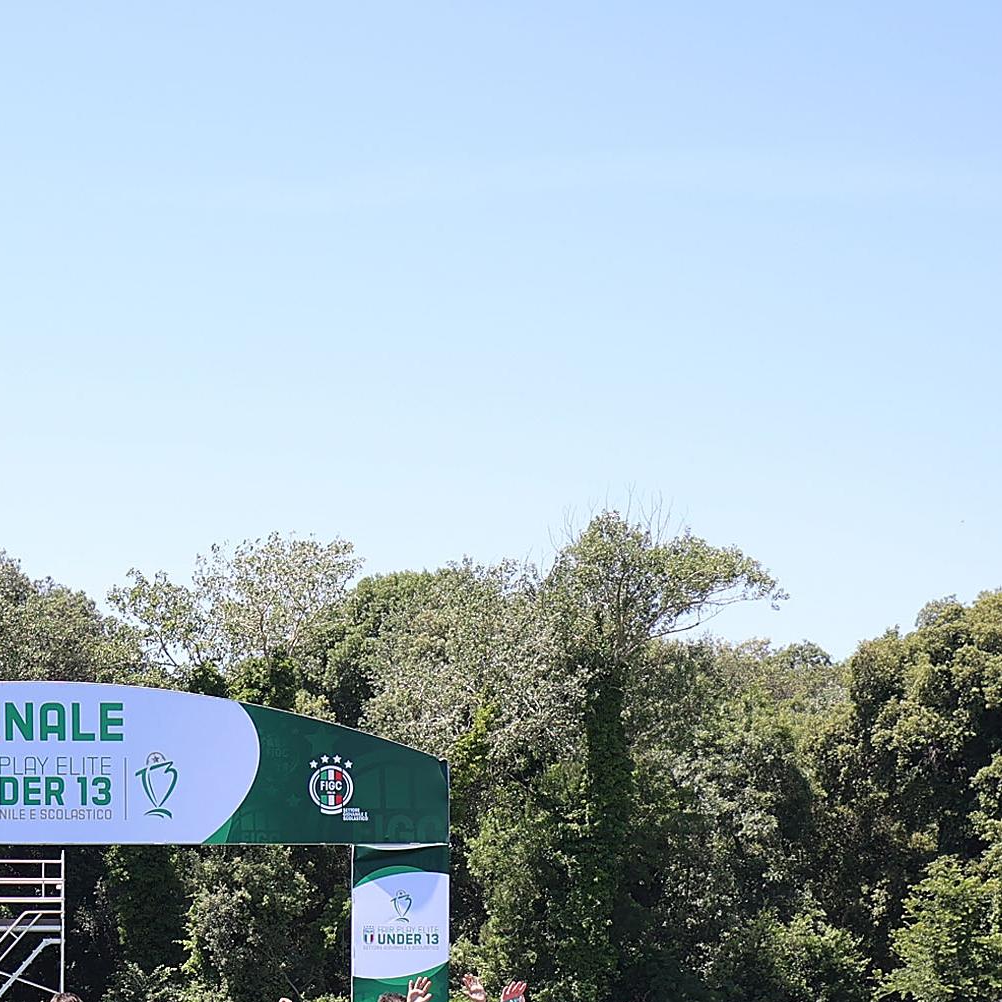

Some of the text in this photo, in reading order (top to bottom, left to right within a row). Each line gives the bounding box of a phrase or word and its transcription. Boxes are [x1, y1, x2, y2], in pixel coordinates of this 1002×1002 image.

[56, 756, 112, 776] ELITE
[76, 776, 112, 806] 13
[319, 780, 343, 791] FIGC
[29, 808, 37, 820] E
[39, 808, 112, 820] SCOLASTICO
[377, 933, 439, 945] UNDER 13
